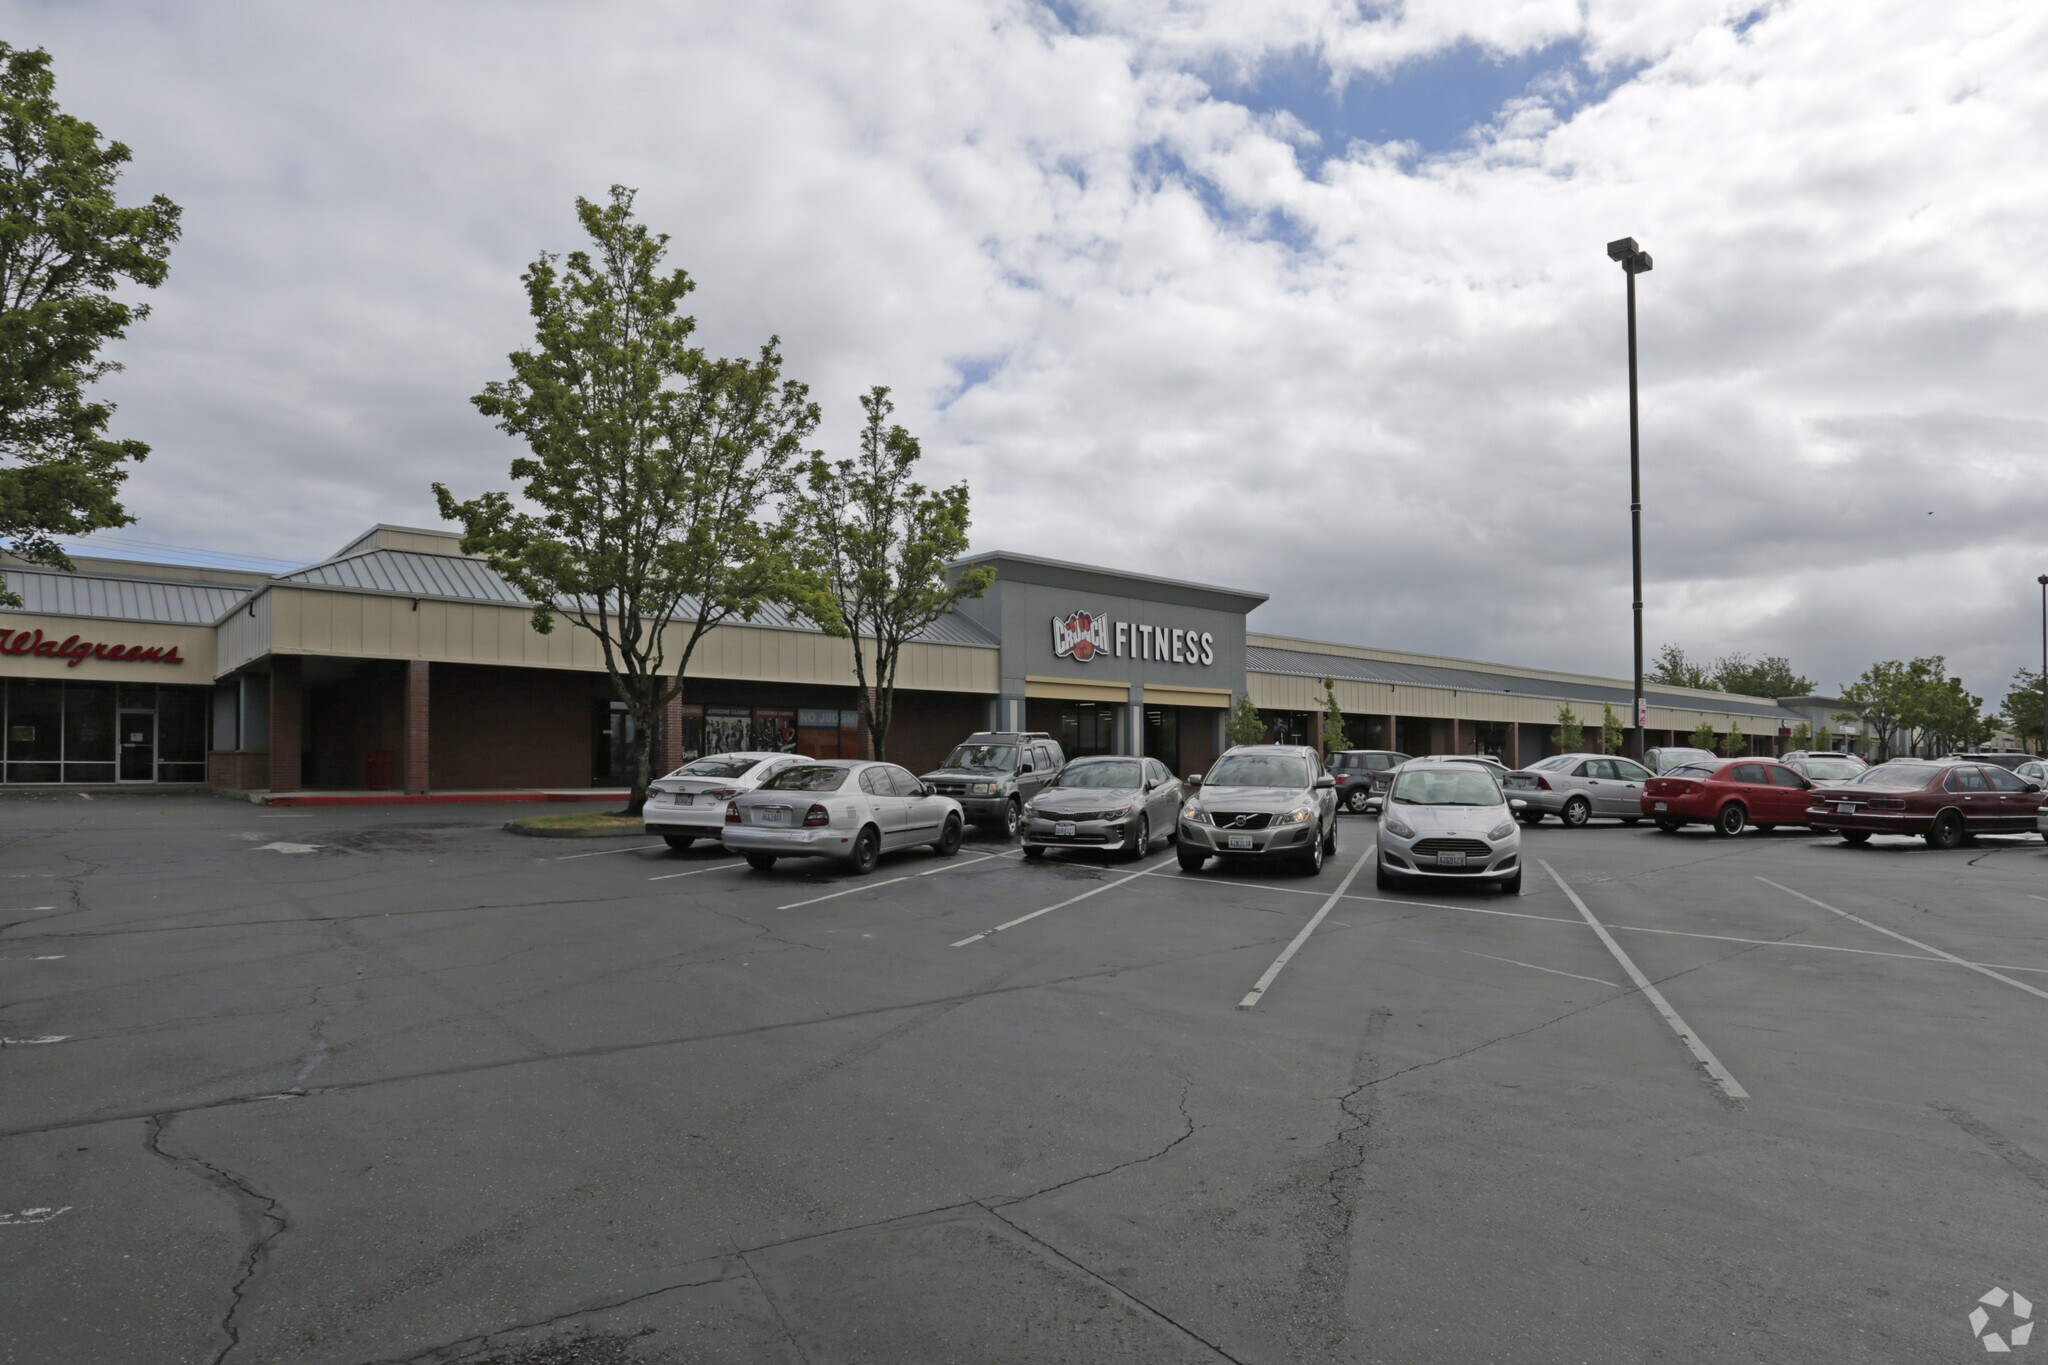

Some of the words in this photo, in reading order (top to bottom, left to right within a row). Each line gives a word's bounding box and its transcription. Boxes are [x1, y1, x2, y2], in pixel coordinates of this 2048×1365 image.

[0, 628, 184, 668] Walgreens
[1054, 612, 1108, 656] CRUNCH
[1115, 621, 1214, 666] FITNESS
[800, 712, 817, 723] NO
